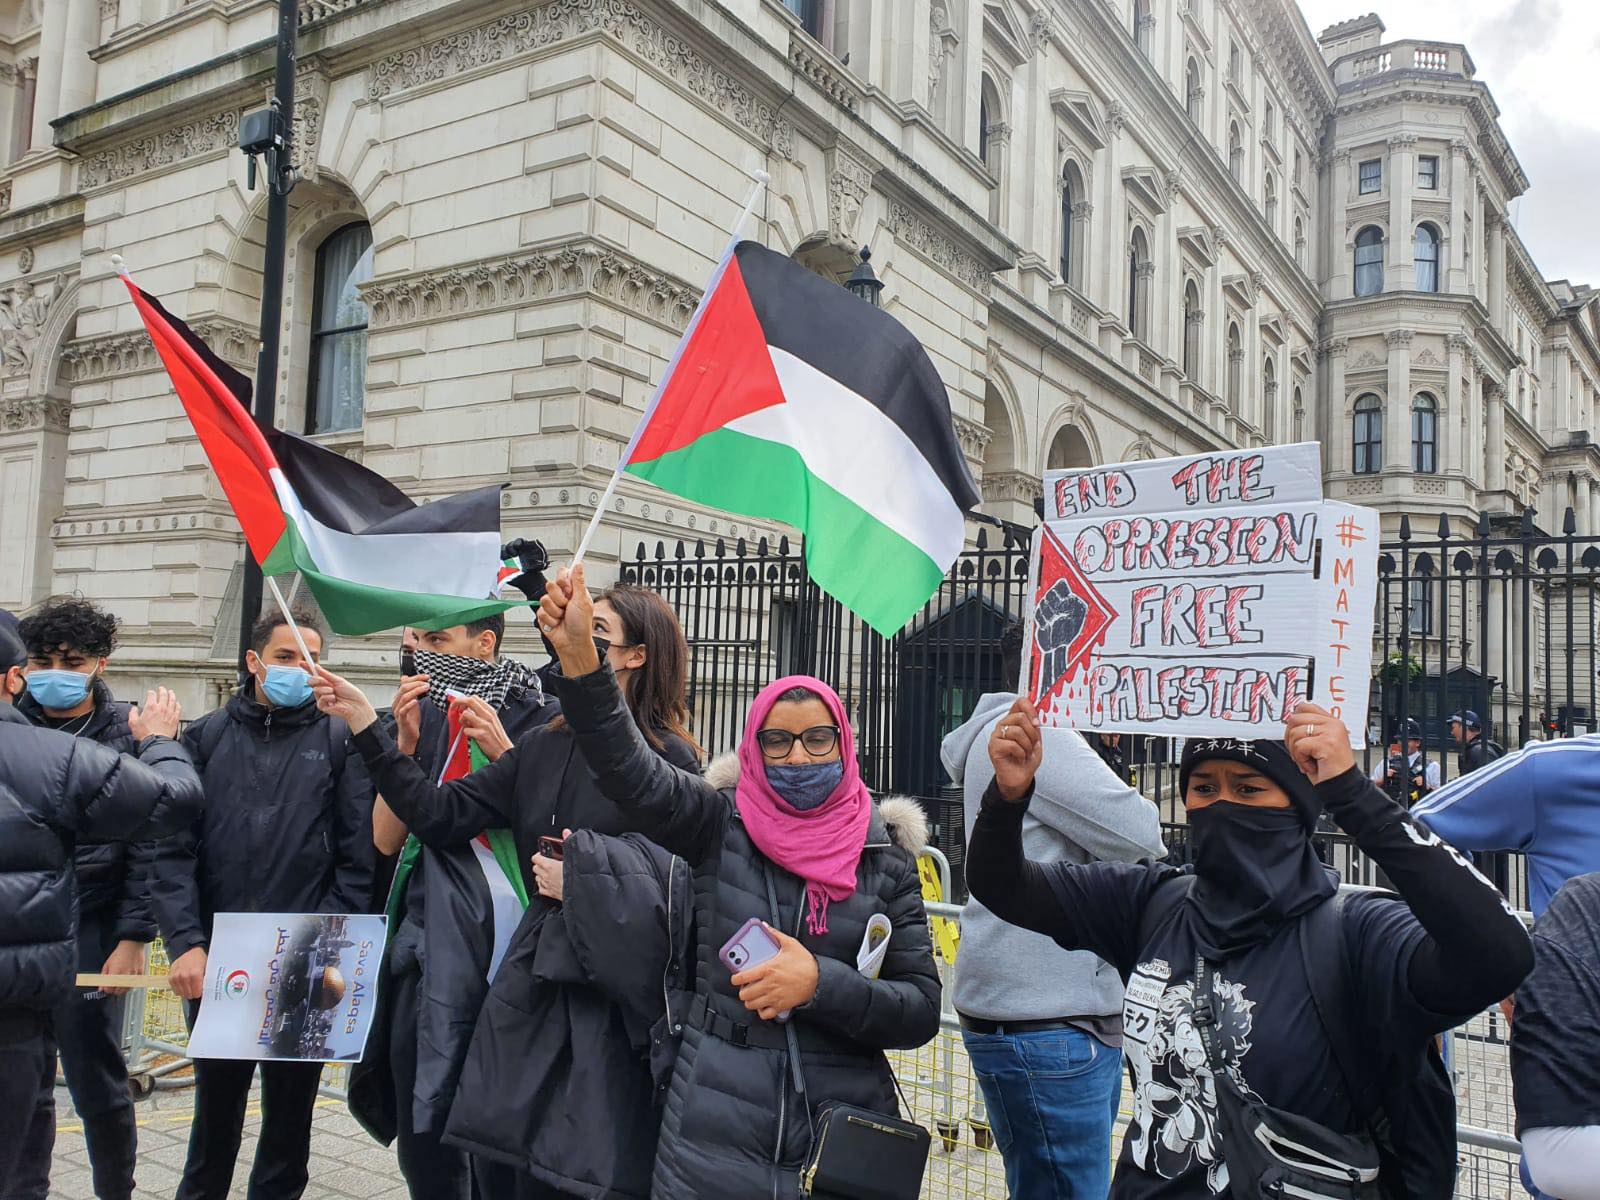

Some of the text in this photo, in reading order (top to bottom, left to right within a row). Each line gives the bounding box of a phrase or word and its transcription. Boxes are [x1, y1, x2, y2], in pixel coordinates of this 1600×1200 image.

[1054, 455, 1274, 518] END THE
[1074, 512, 1317, 574] OPPRESSION
[1130, 584, 1263, 648] FREE
[1089, 664, 1308, 726] PALESTINE
[276, 927, 290, 955] خطر
[345, 940, 373, 1034] Save Alaqsa
[1125, 1007, 1150, 1033] デク
